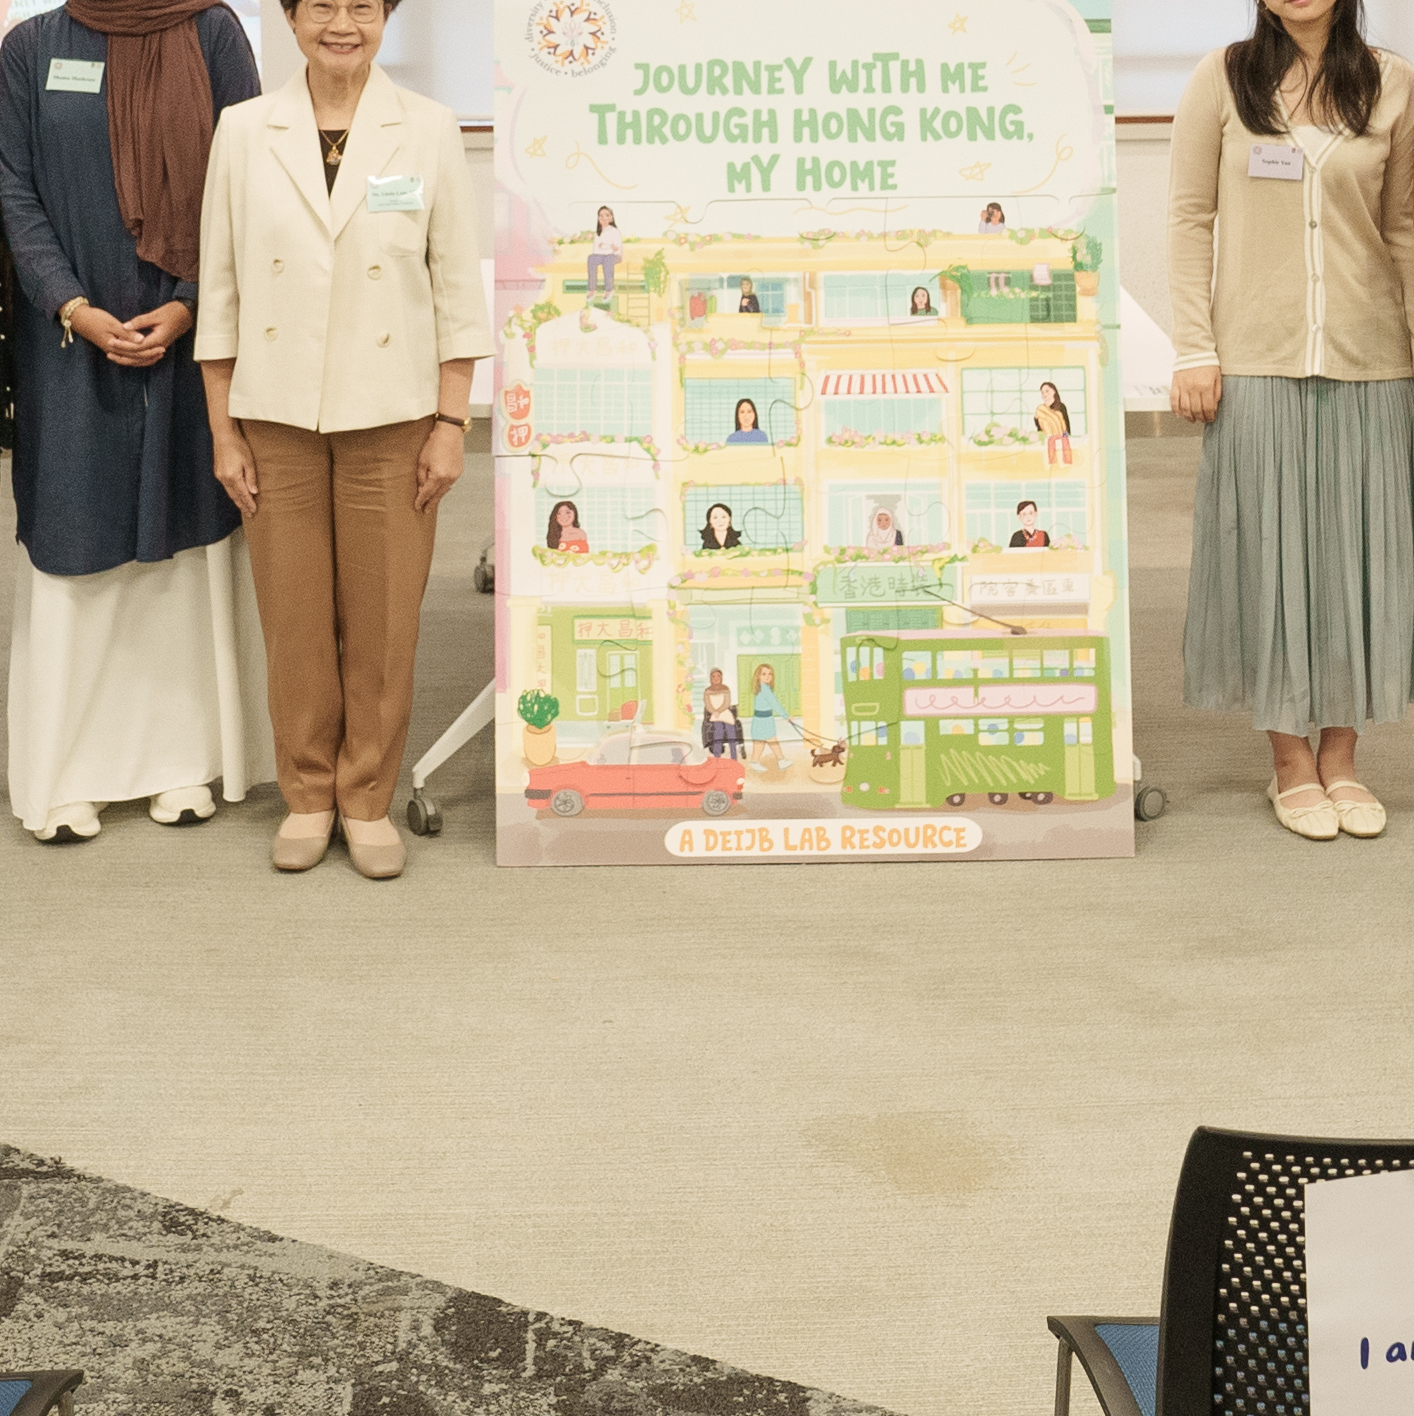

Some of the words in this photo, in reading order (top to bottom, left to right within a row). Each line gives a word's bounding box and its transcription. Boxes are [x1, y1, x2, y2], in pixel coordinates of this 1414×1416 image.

[525, 0, 544, 42] diversity
[528, 52, 561, 76] justice
[571, 46, 617, 78] belonging
[633, 56, 814, 97] JOURNEY
[828, 52, 926, 95] WITH
[940, 60, 989, 94] ME
[589, 103, 779, 145] THROUGH
[792, 104, 906, 144] HONG
[919, 103, 1035, 144] KONG,
[726, 154, 781, 193] MY
[795, 156, 898, 193] HOME
[679, 829, 694, 853] A
[703, 827, 775, 853] DEIJB
[784, 827, 832, 852] LAB
[841, 824, 968, 850] RESOURCE
[1360, 1337, 1370, 1370] I
